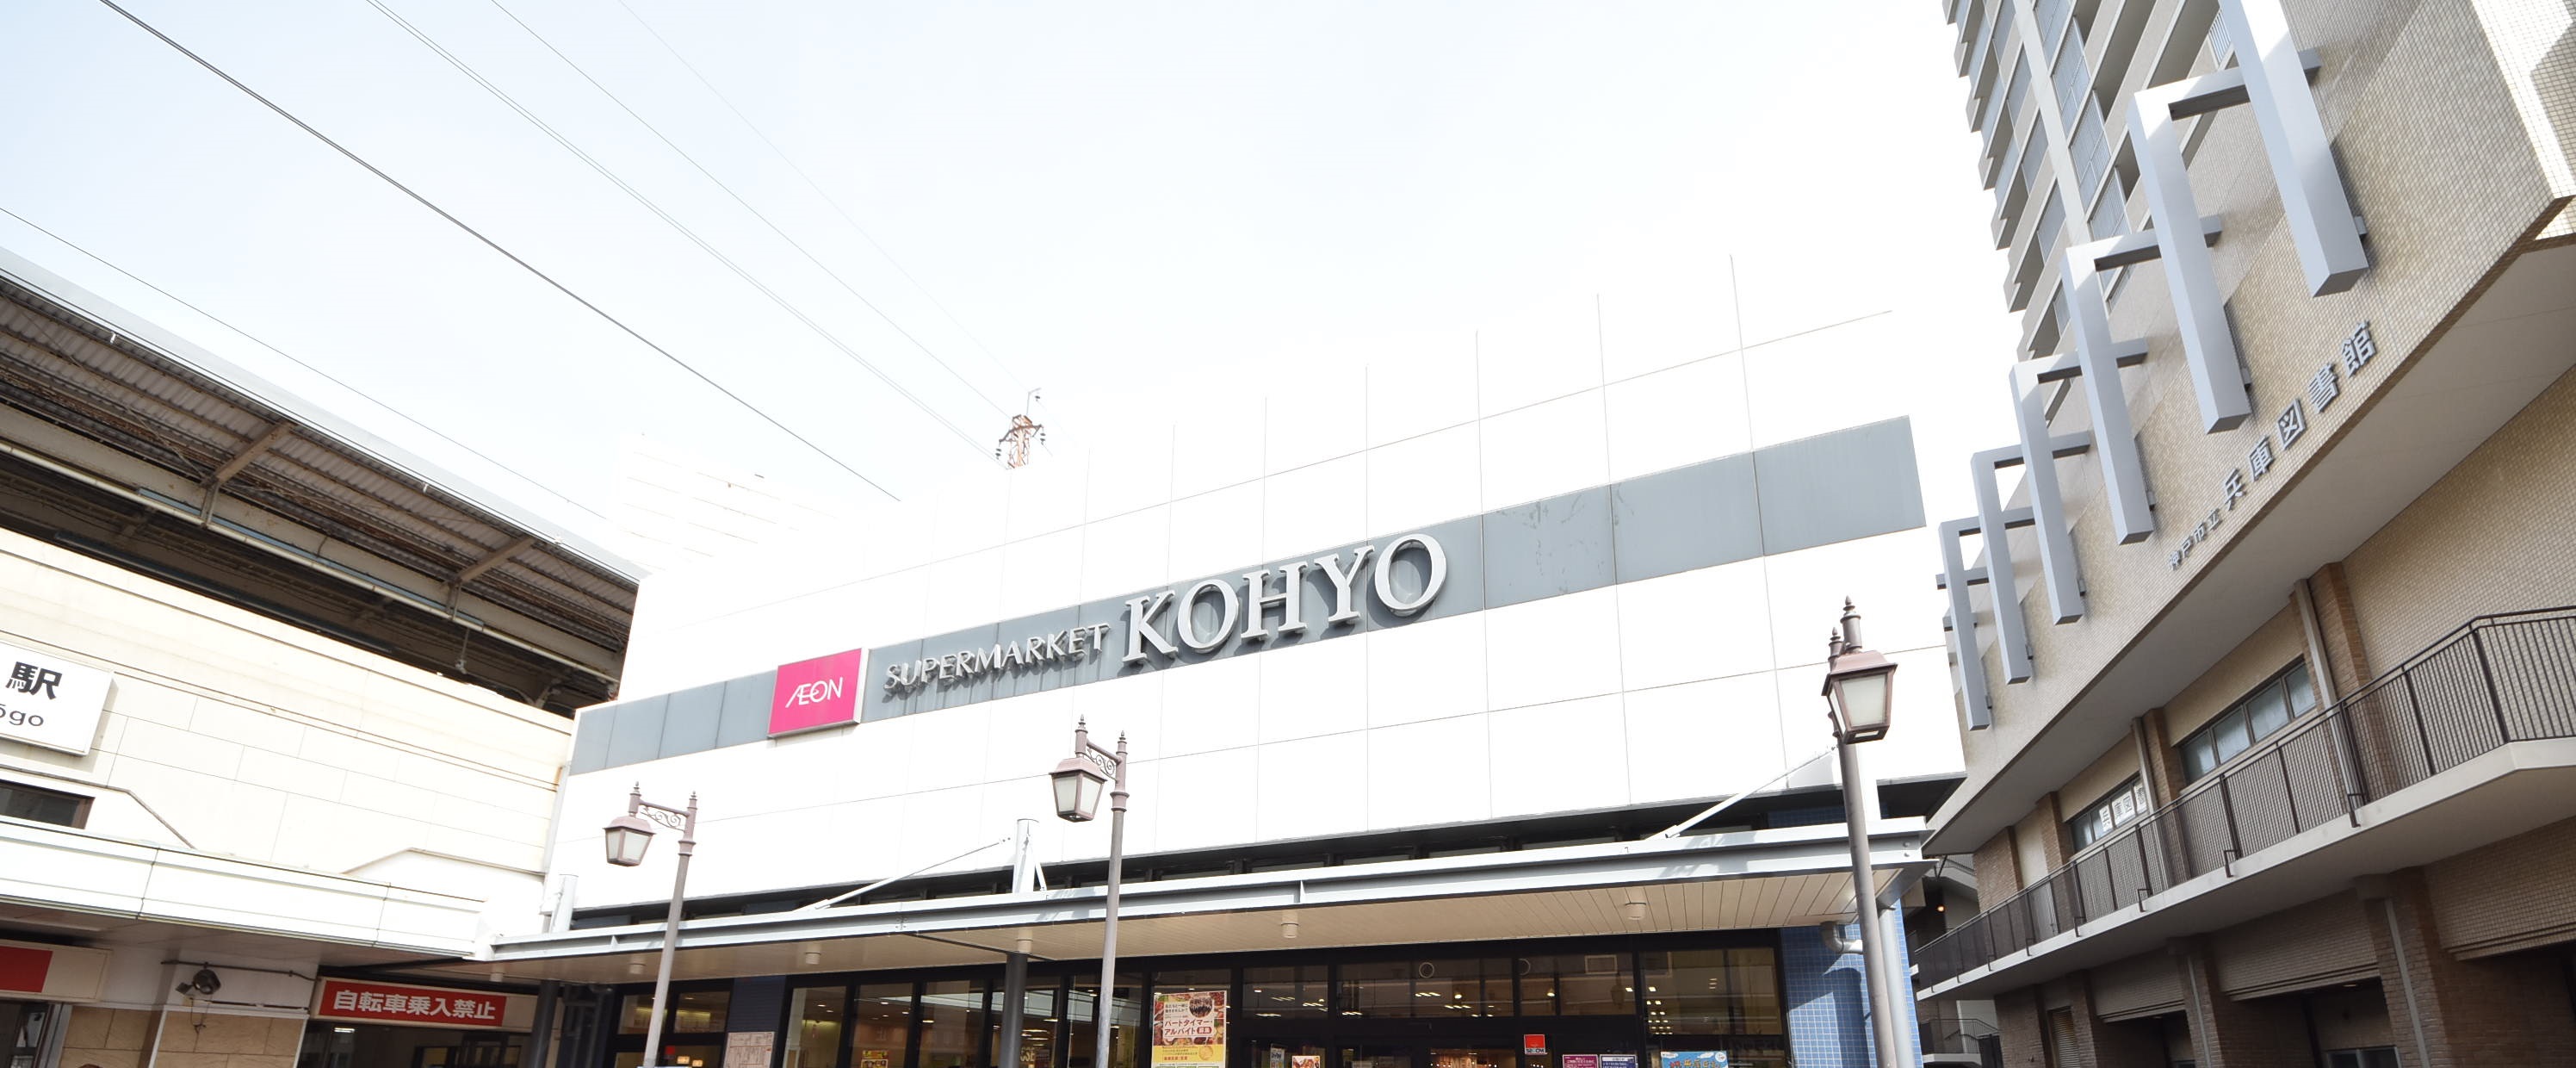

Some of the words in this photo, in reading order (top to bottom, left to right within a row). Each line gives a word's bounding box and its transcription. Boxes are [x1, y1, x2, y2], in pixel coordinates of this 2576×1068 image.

[2169, 509, 2223, 571] 神戸市立
[2224, 320, 2377, 511] 兵庫図書館
[883, 623, 1111, 690] SUPERMARKET
[1122, 533, 1447, 663] KOHYO
[5, 661, 63, 700] 駅
[332, 990, 496, 1020] 自転車乗入禁止
